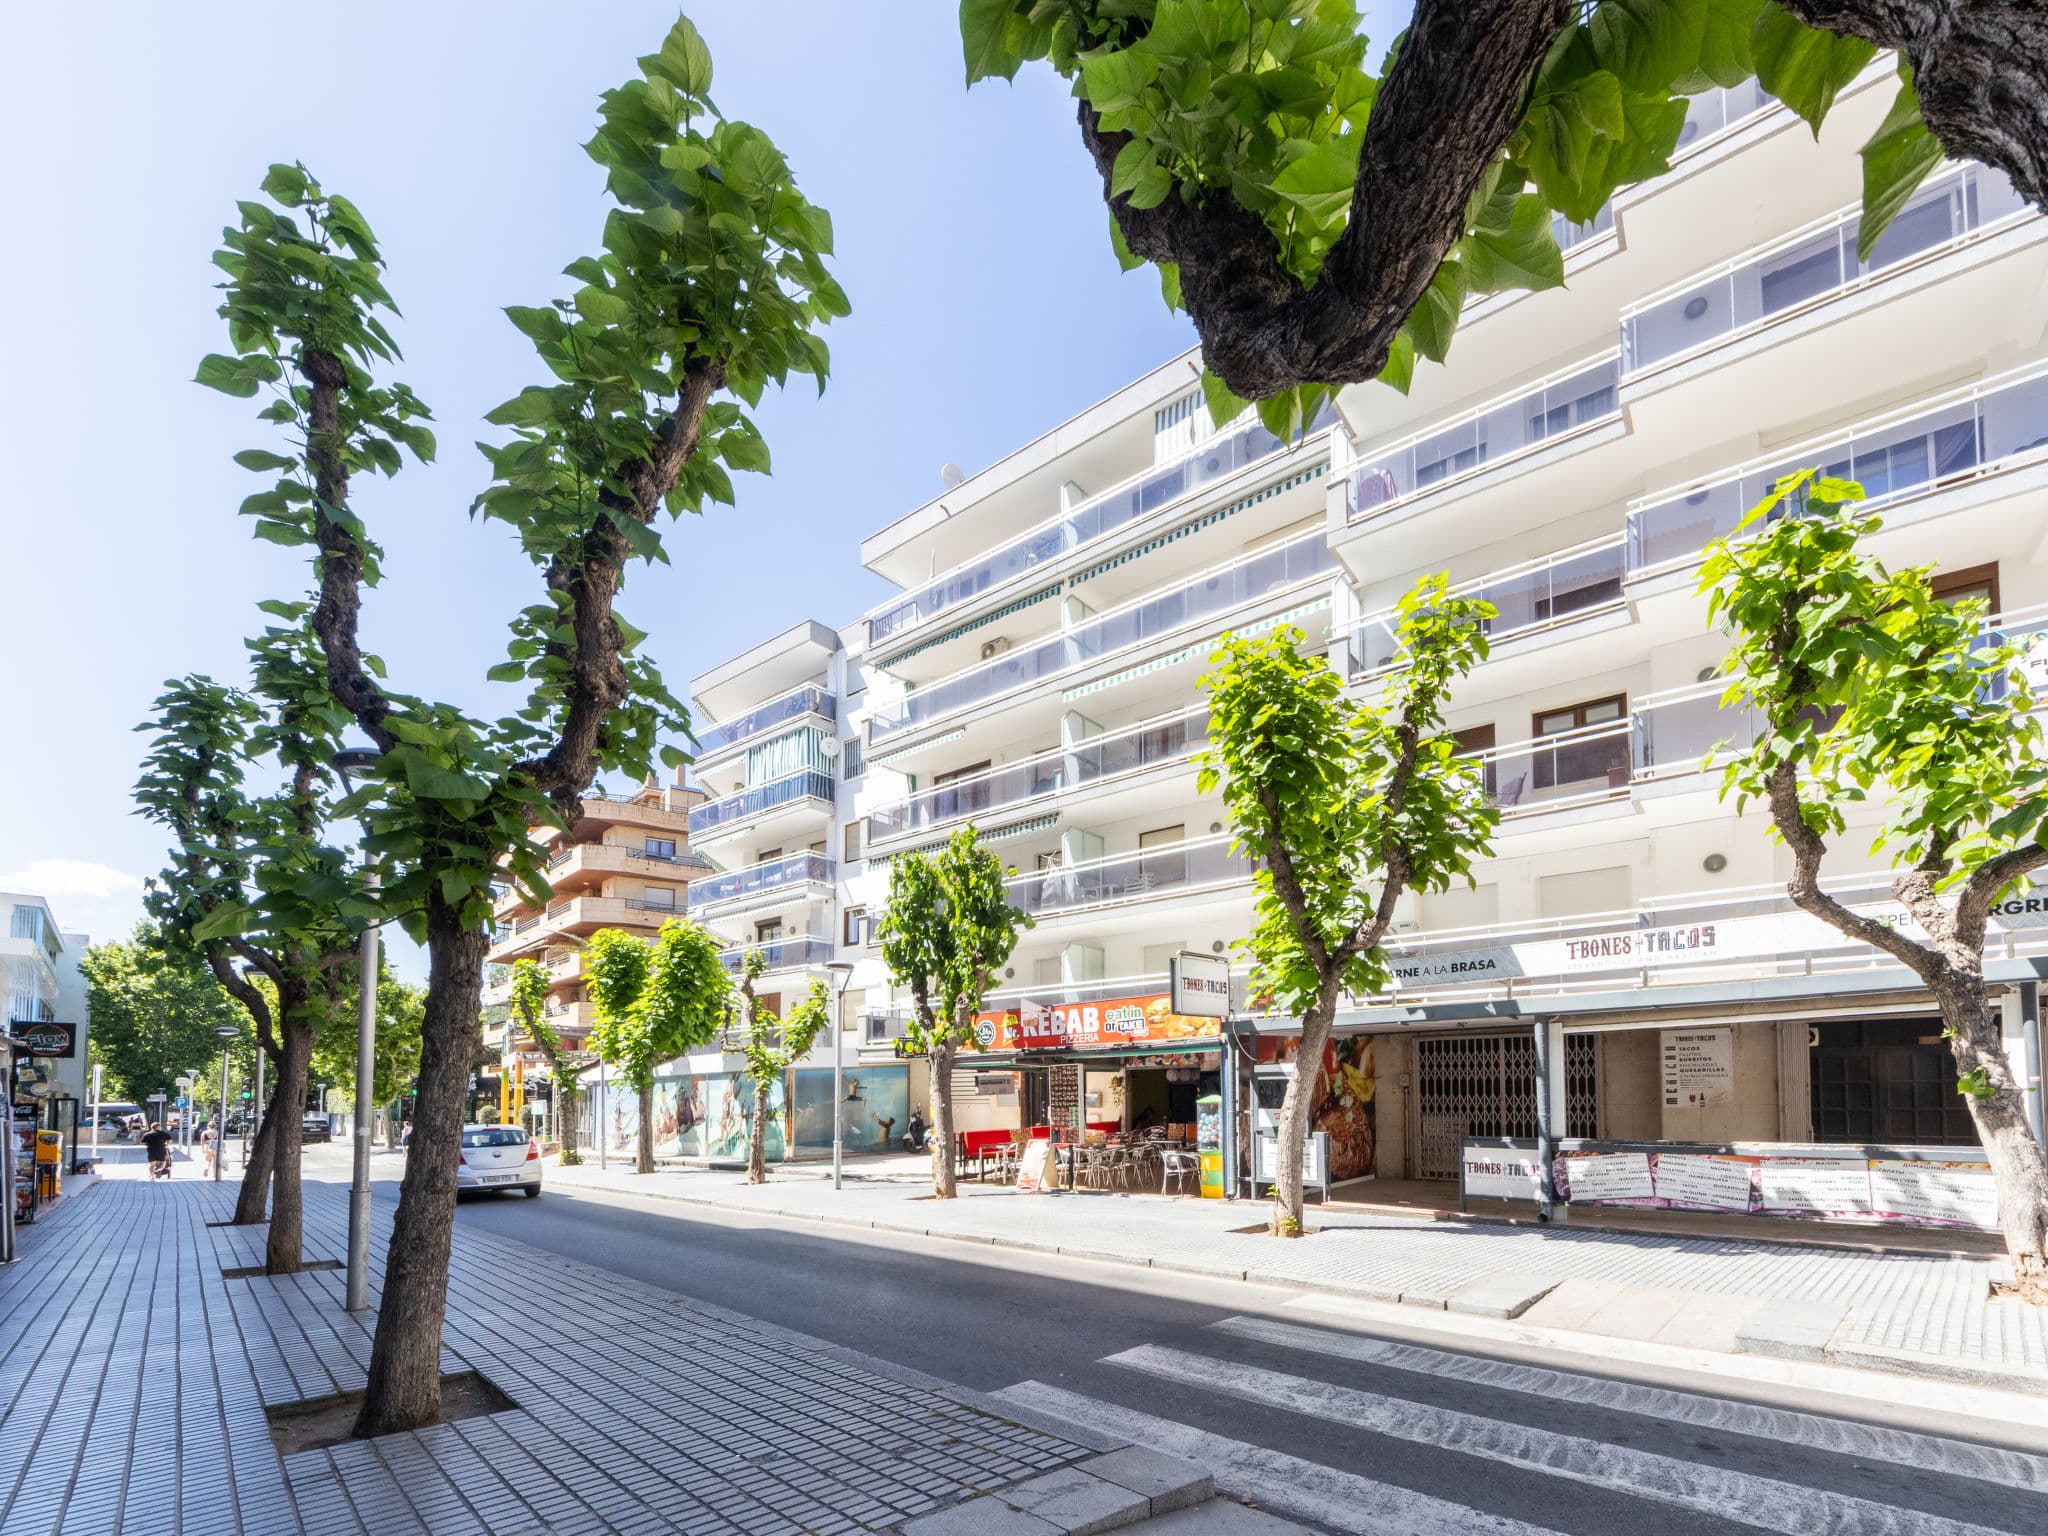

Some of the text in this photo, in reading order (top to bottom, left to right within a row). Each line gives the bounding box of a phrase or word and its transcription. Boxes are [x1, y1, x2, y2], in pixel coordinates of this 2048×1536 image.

[1644, 925, 1716, 952] TACOS
[1388, 959, 1497, 979] ARNE A LA BRASA
[1107, 1006, 1142, 1020] eat in
[1105, 1022, 1115, 1031] or
[1060, 1032, 1100, 1044] PIZZERIA
